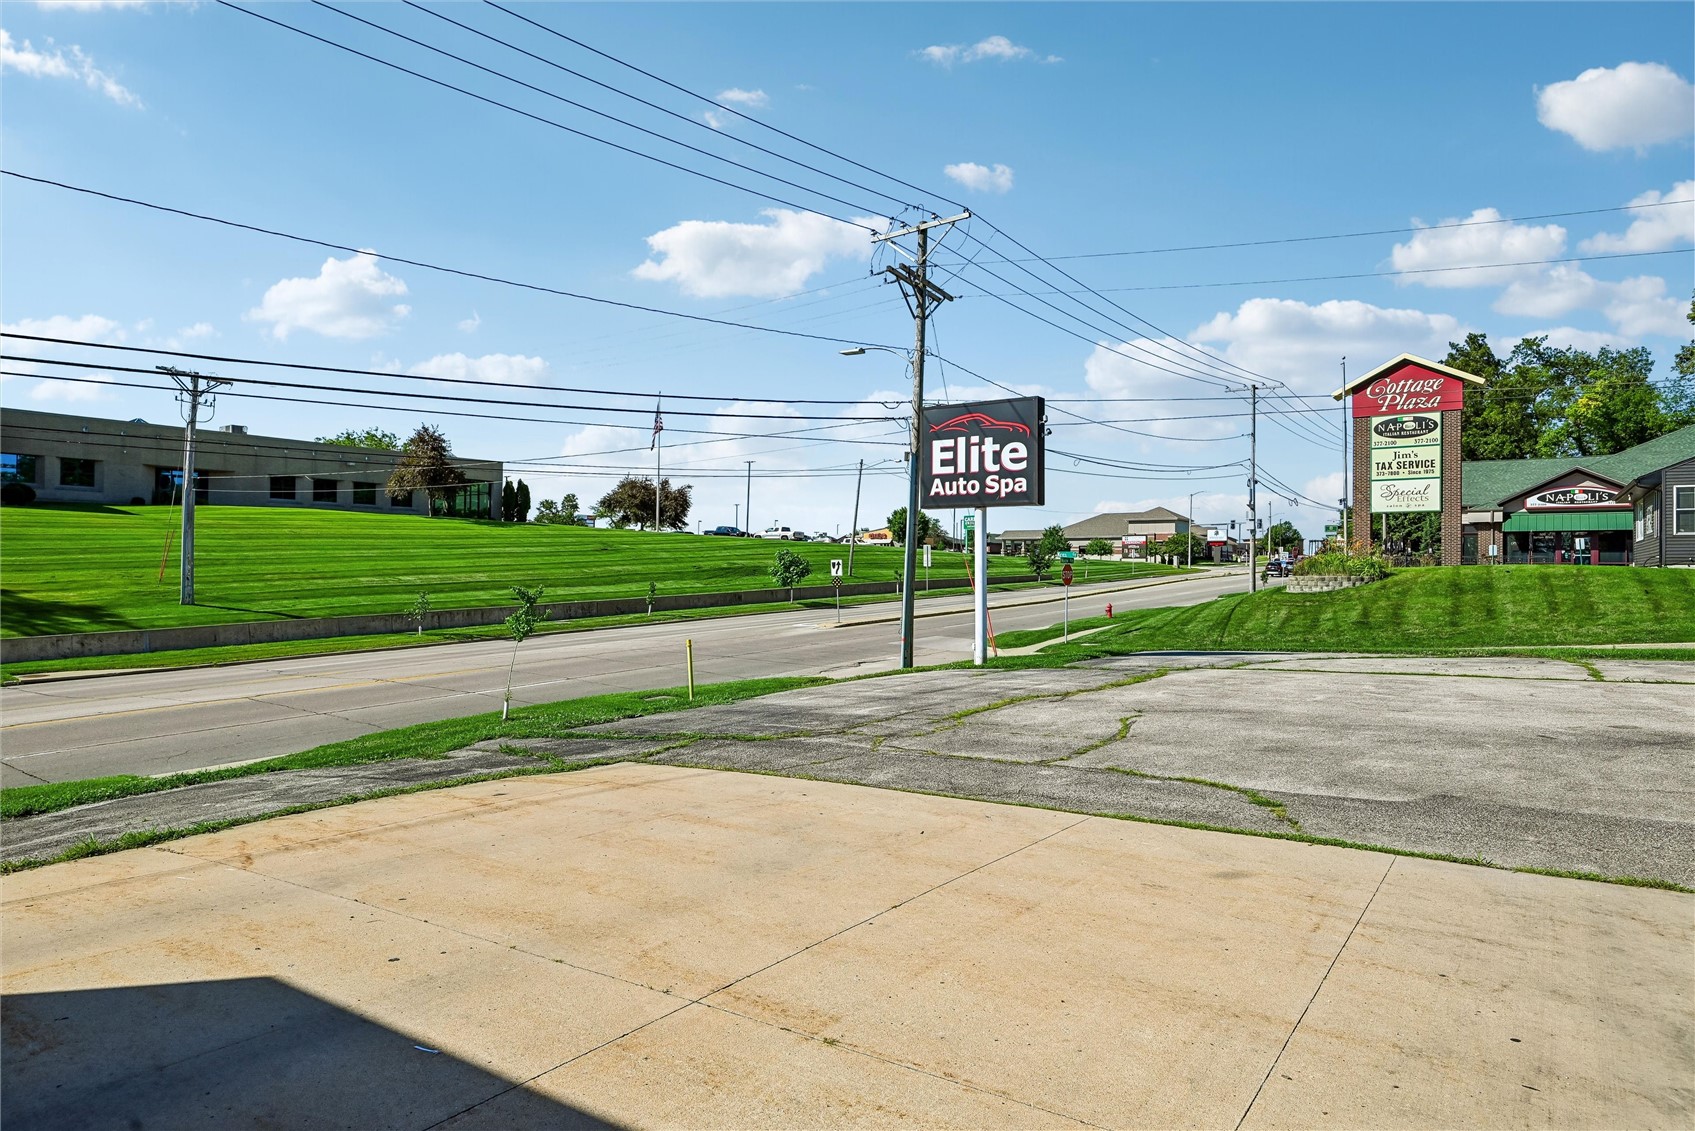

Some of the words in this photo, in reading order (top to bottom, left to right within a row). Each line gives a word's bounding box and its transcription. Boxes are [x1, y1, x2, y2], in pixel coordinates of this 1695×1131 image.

[1366, 378, 1444, 398] Cottage
[1377, 394, 1441, 412] Plaza
[1378, 419, 1434, 432] NAPOLI'S
[931, 436, 1028, 475] Elite
[1392, 451, 1419, 461] Jim's
[1375, 461, 1393, 471] TAX
[1396, 459, 1436, 470] SERVICE
[929, 477, 980, 496] Auto
[985, 475, 1027, 498] Spa
[1380, 484, 1430, 500] Special
[1546, 492, 1609, 502] NAPOLI'S
[1062, 570, 1073, 578] STOP
